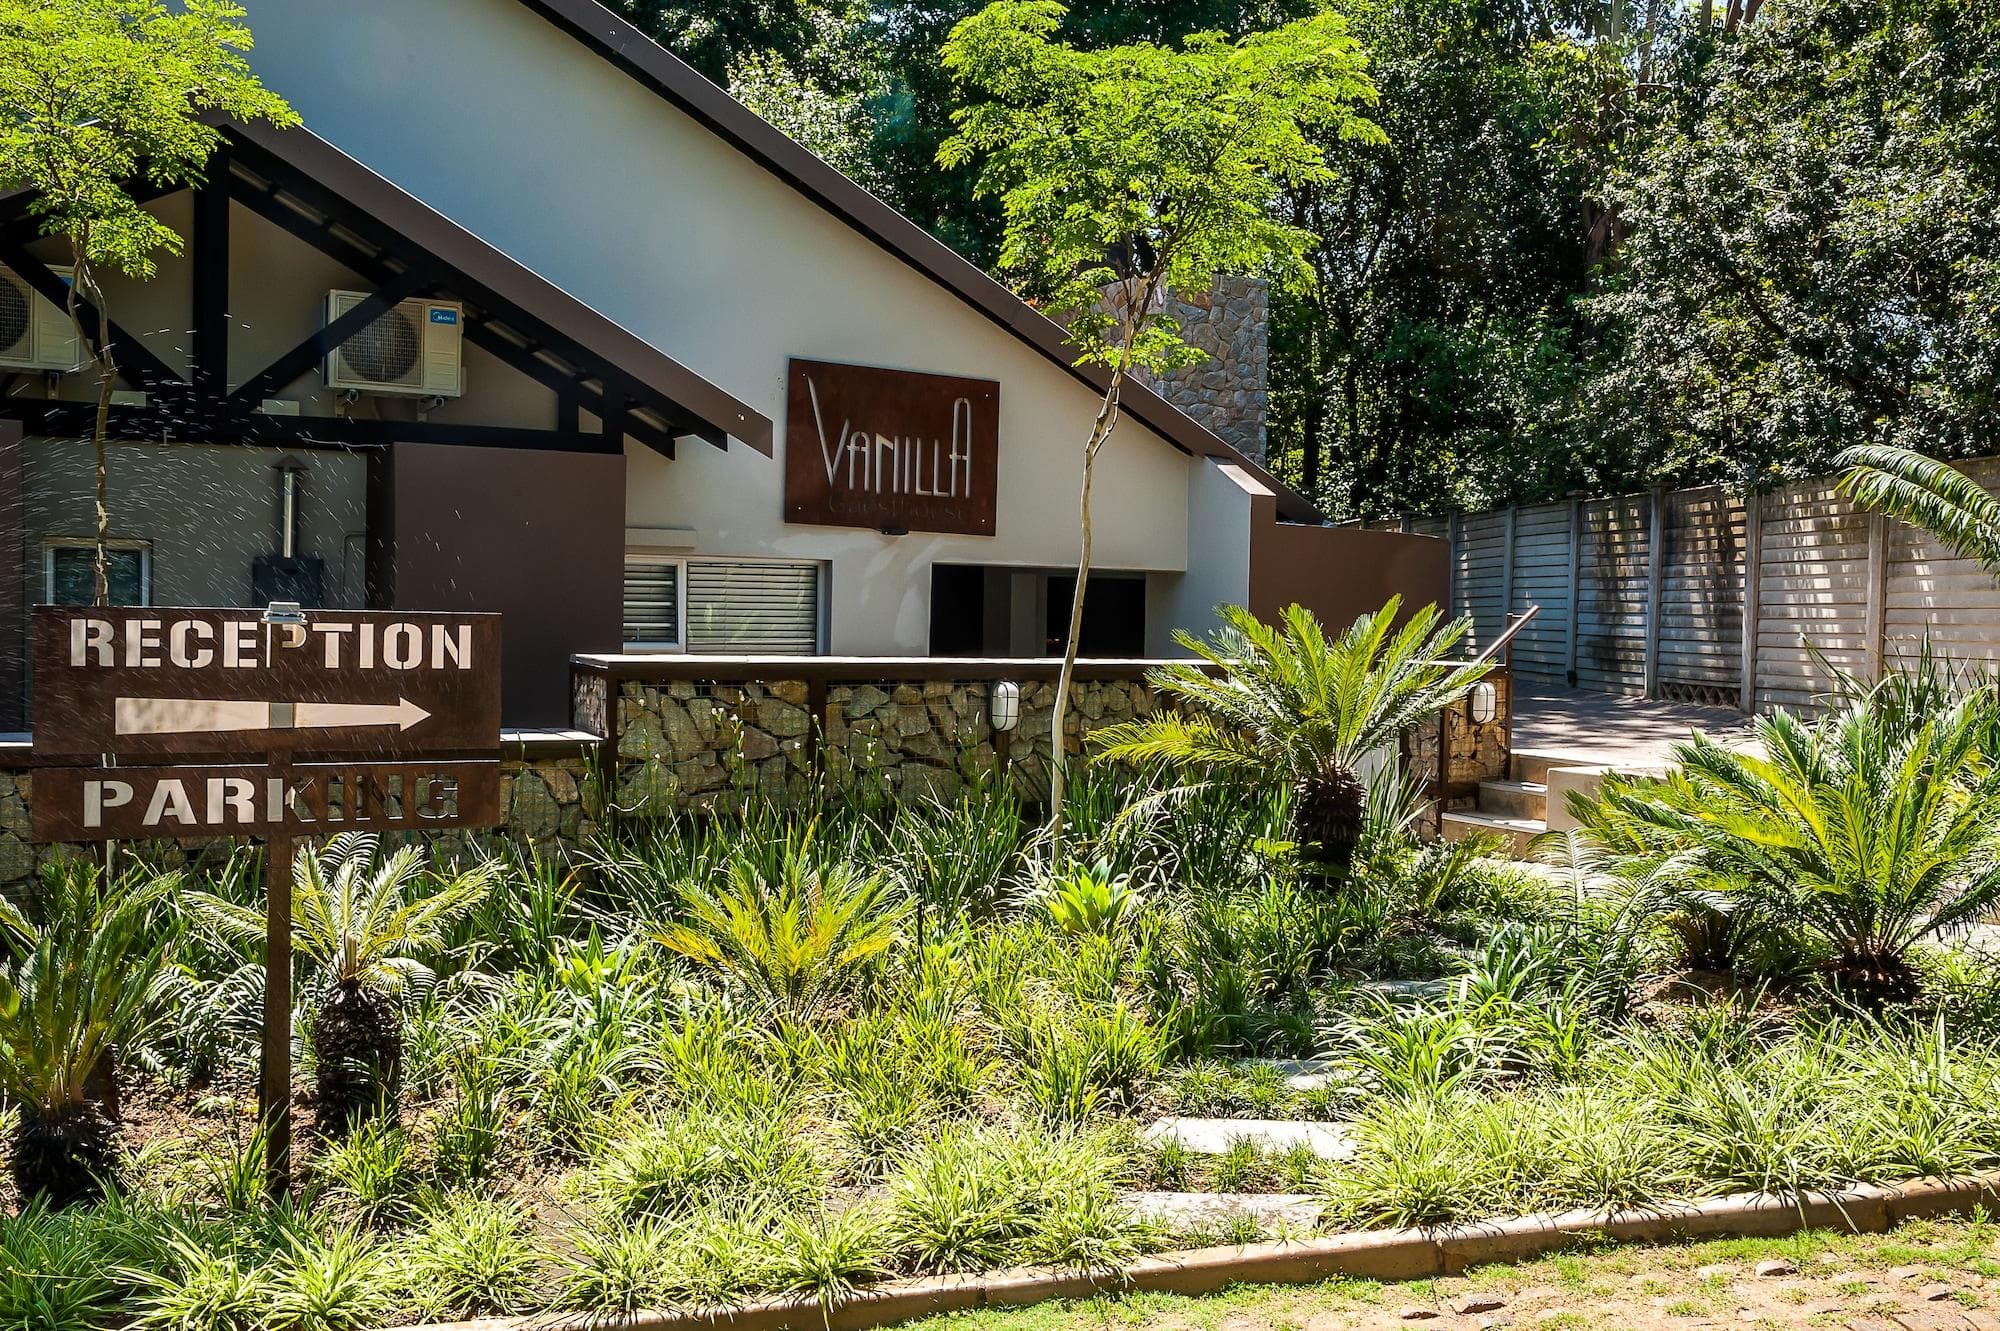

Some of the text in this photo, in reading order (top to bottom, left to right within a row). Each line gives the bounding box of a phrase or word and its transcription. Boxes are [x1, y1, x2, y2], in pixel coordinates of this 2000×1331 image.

[807, 375, 972, 498] VANILLA
[69, 618, 472, 671] RECEPTION
[83, 776, 459, 828] PARKING
